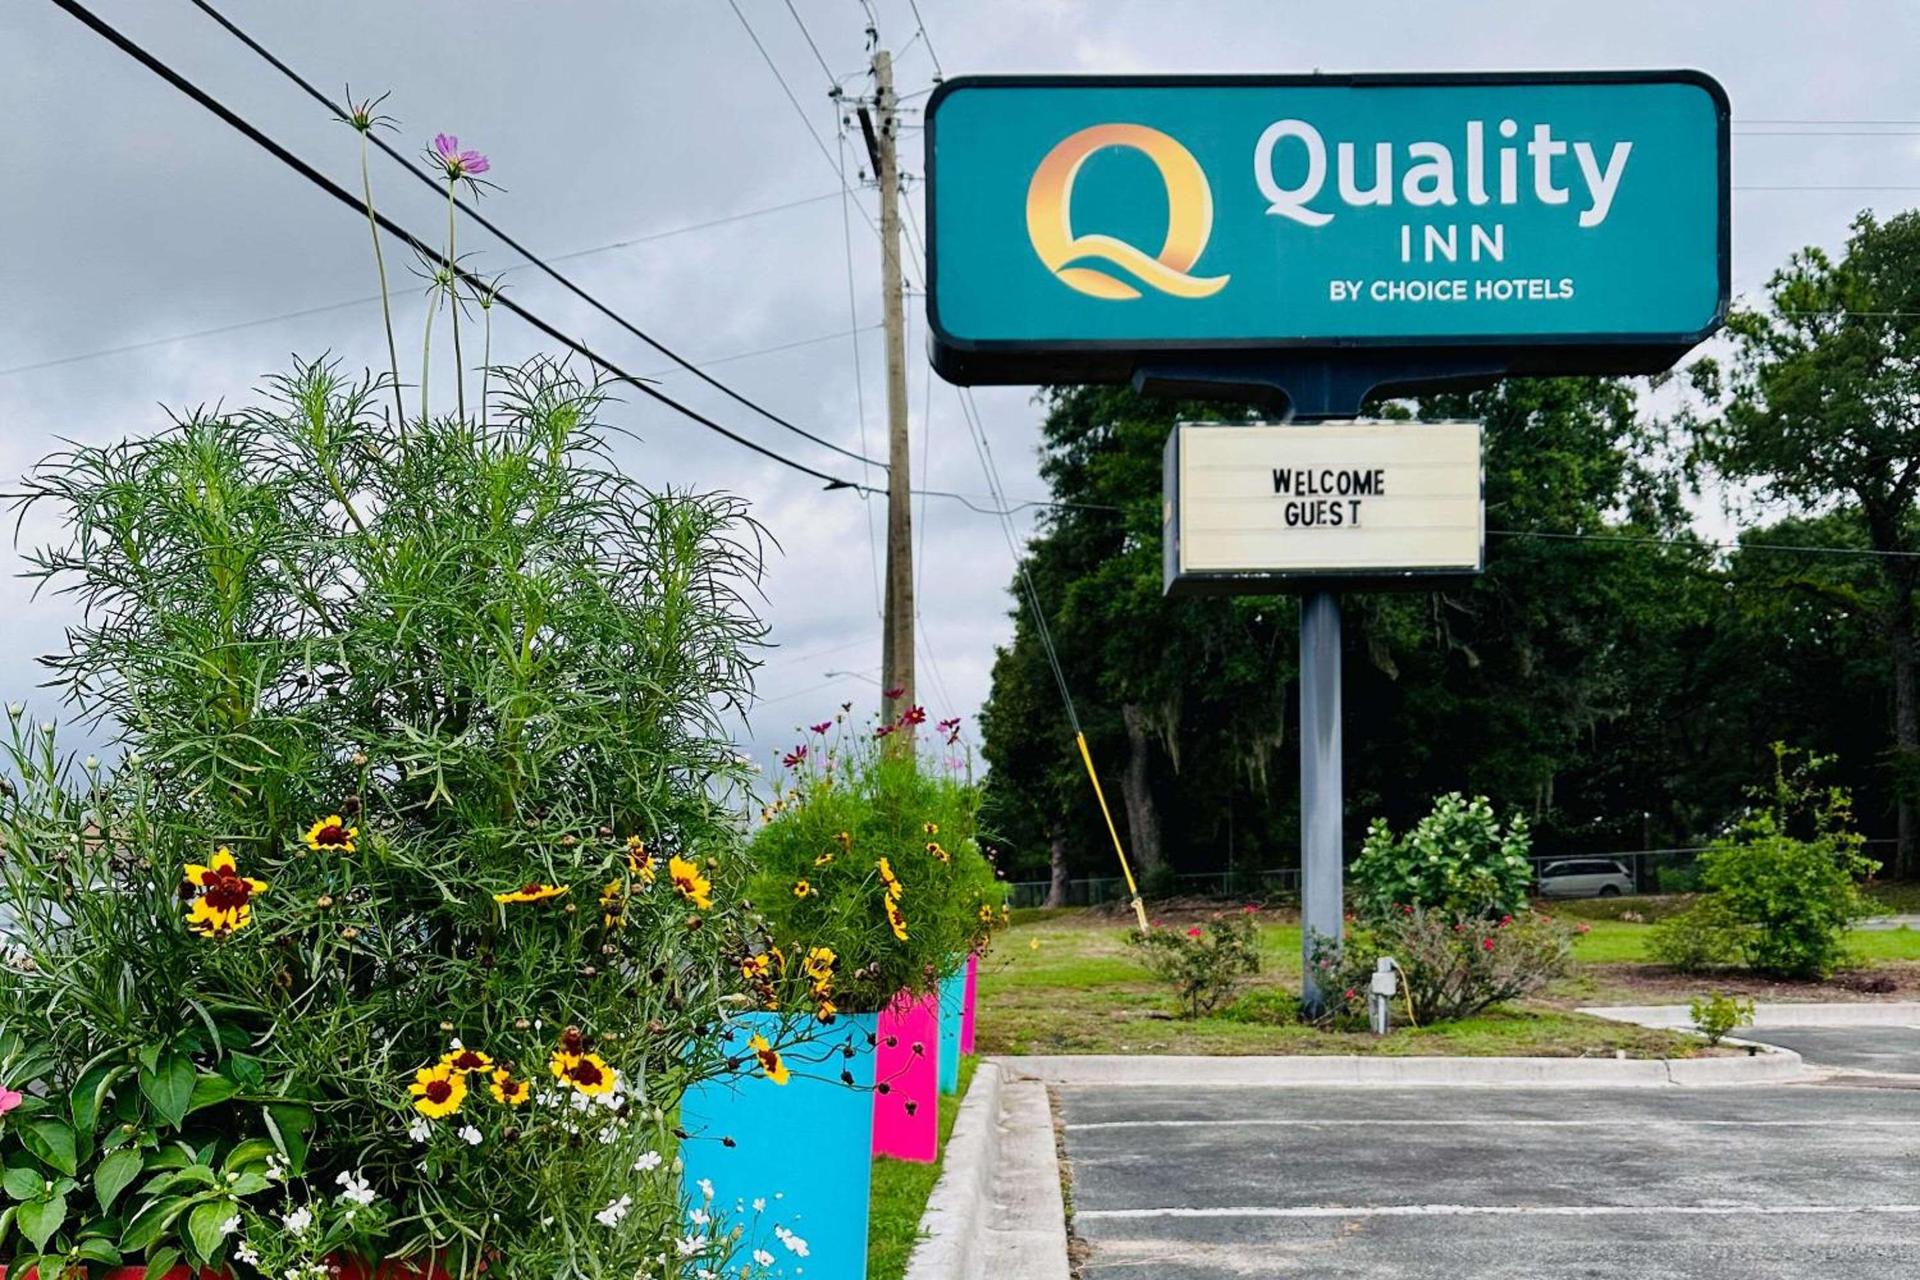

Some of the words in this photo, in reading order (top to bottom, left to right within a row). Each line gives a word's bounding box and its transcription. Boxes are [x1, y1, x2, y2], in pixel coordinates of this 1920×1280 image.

[1253, 118, 1633, 229] Quality
[1400, 224, 1505, 263] INN
[1329, 280, 1363, 301] BY
[1370, 279, 1467, 301] CHOICE
[1475, 278, 1574, 300] HOTELS
[1272, 468, 1386, 497] WELCOME
[1284, 499, 1362, 527] GUEST
